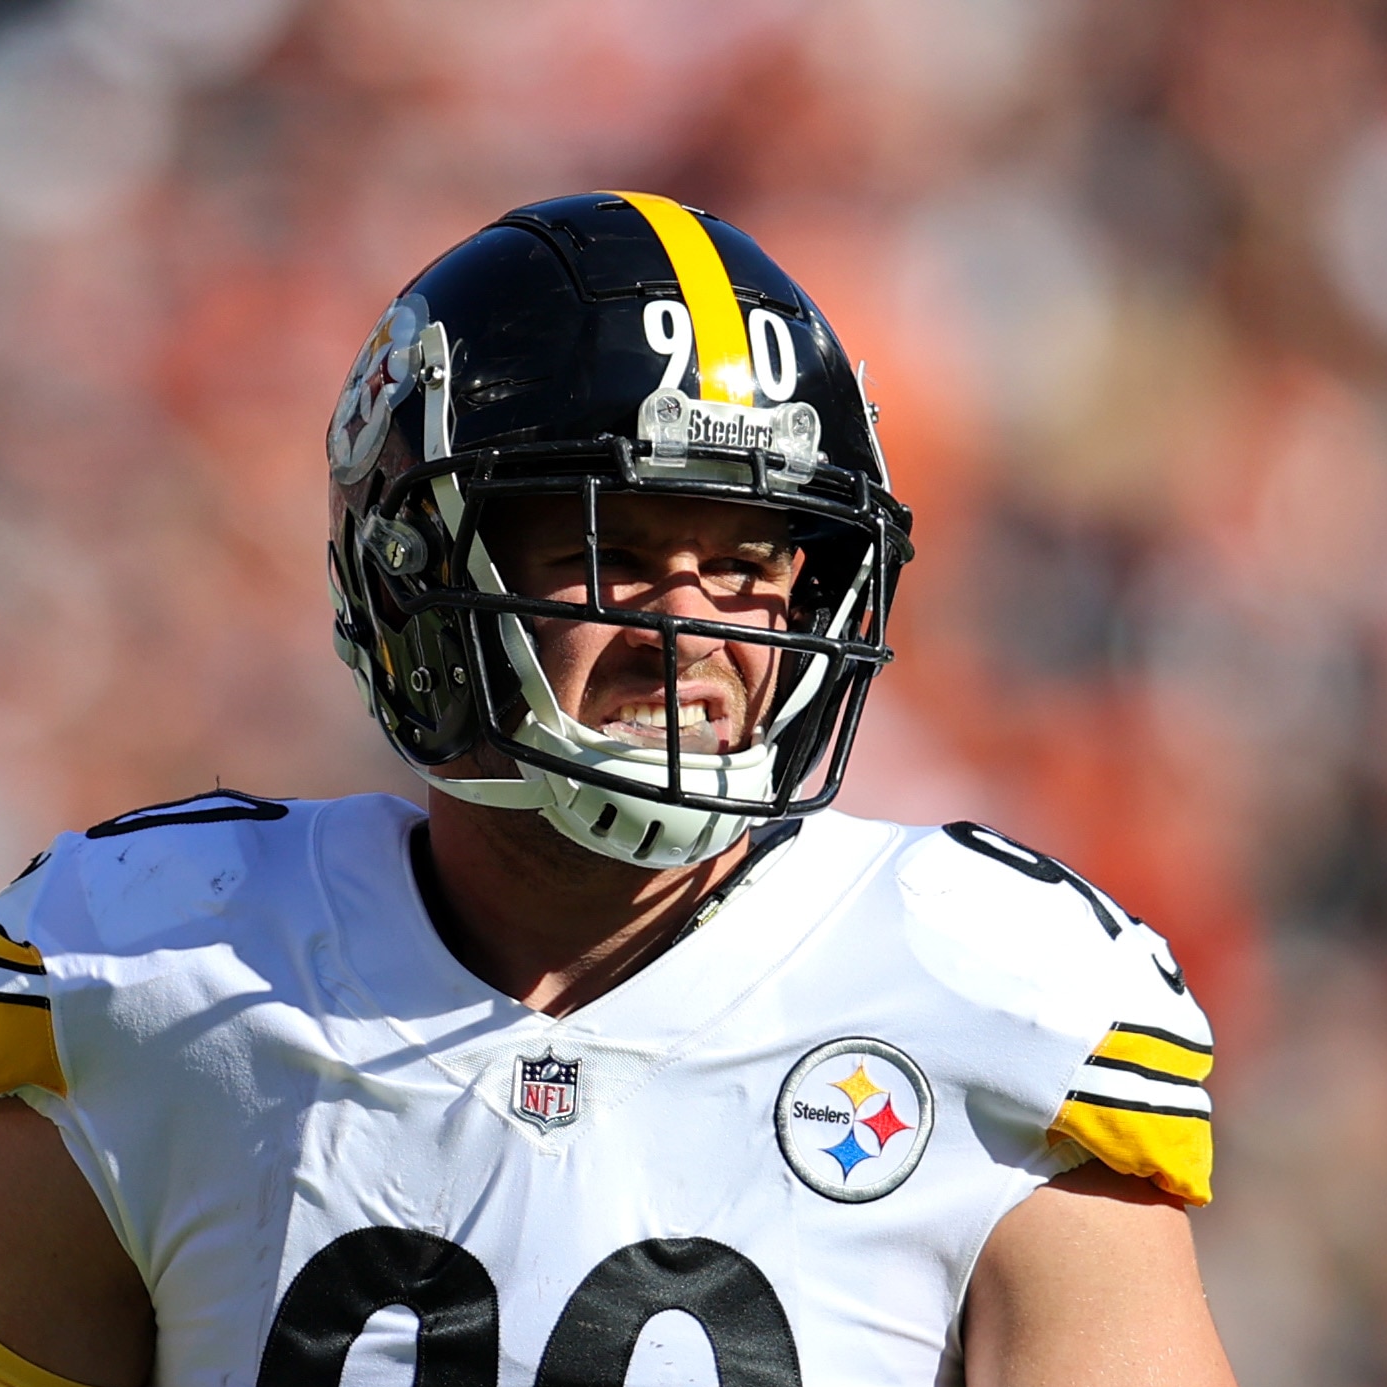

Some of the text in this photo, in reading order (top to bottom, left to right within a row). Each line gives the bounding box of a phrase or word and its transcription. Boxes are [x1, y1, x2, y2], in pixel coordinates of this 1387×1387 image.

[643, 299, 797, 402] 90
[687, 409, 773, 449] Steelers
[524, 1084, 570, 1116] NFL
[793, 1100, 851, 1125] Steelers
